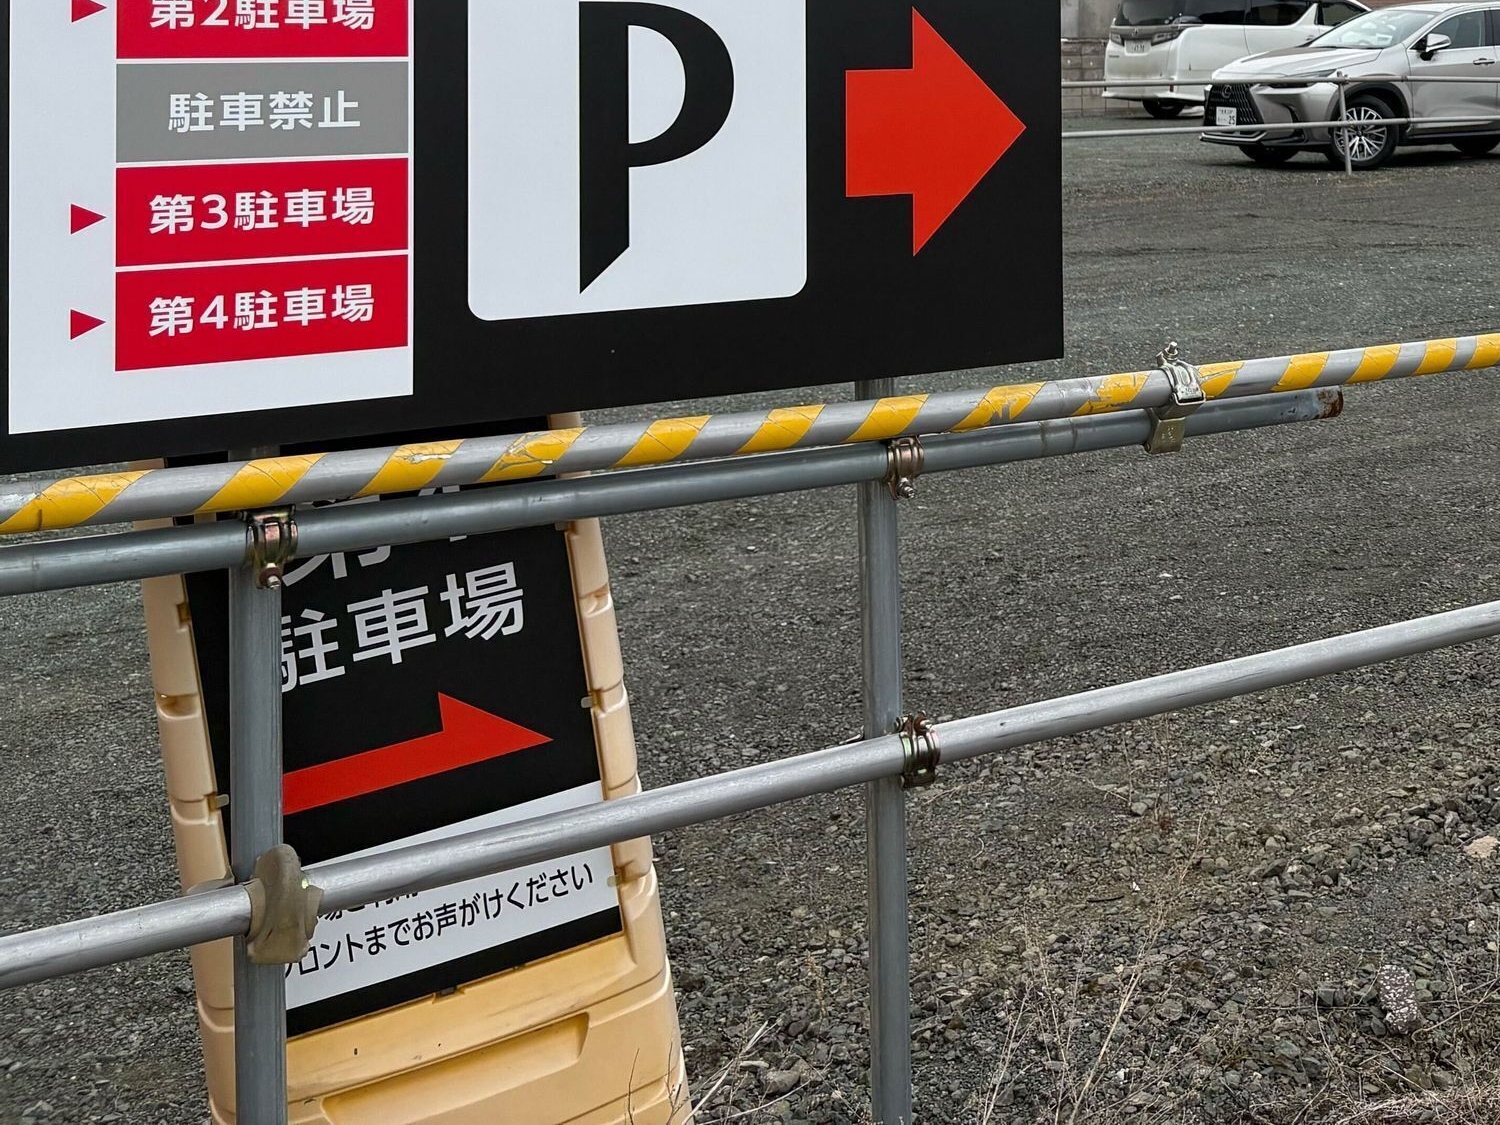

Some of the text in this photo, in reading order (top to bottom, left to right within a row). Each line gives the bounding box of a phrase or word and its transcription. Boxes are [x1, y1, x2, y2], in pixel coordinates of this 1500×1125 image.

[168, 90, 361, 133] 駐車禁止
[579, 1, 735, 294] P
[149, 187, 375, 235] 第3駐車場
[148, 283, 374, 337] 第4駐車場
[281, 561, 525, 694] 駐車場
